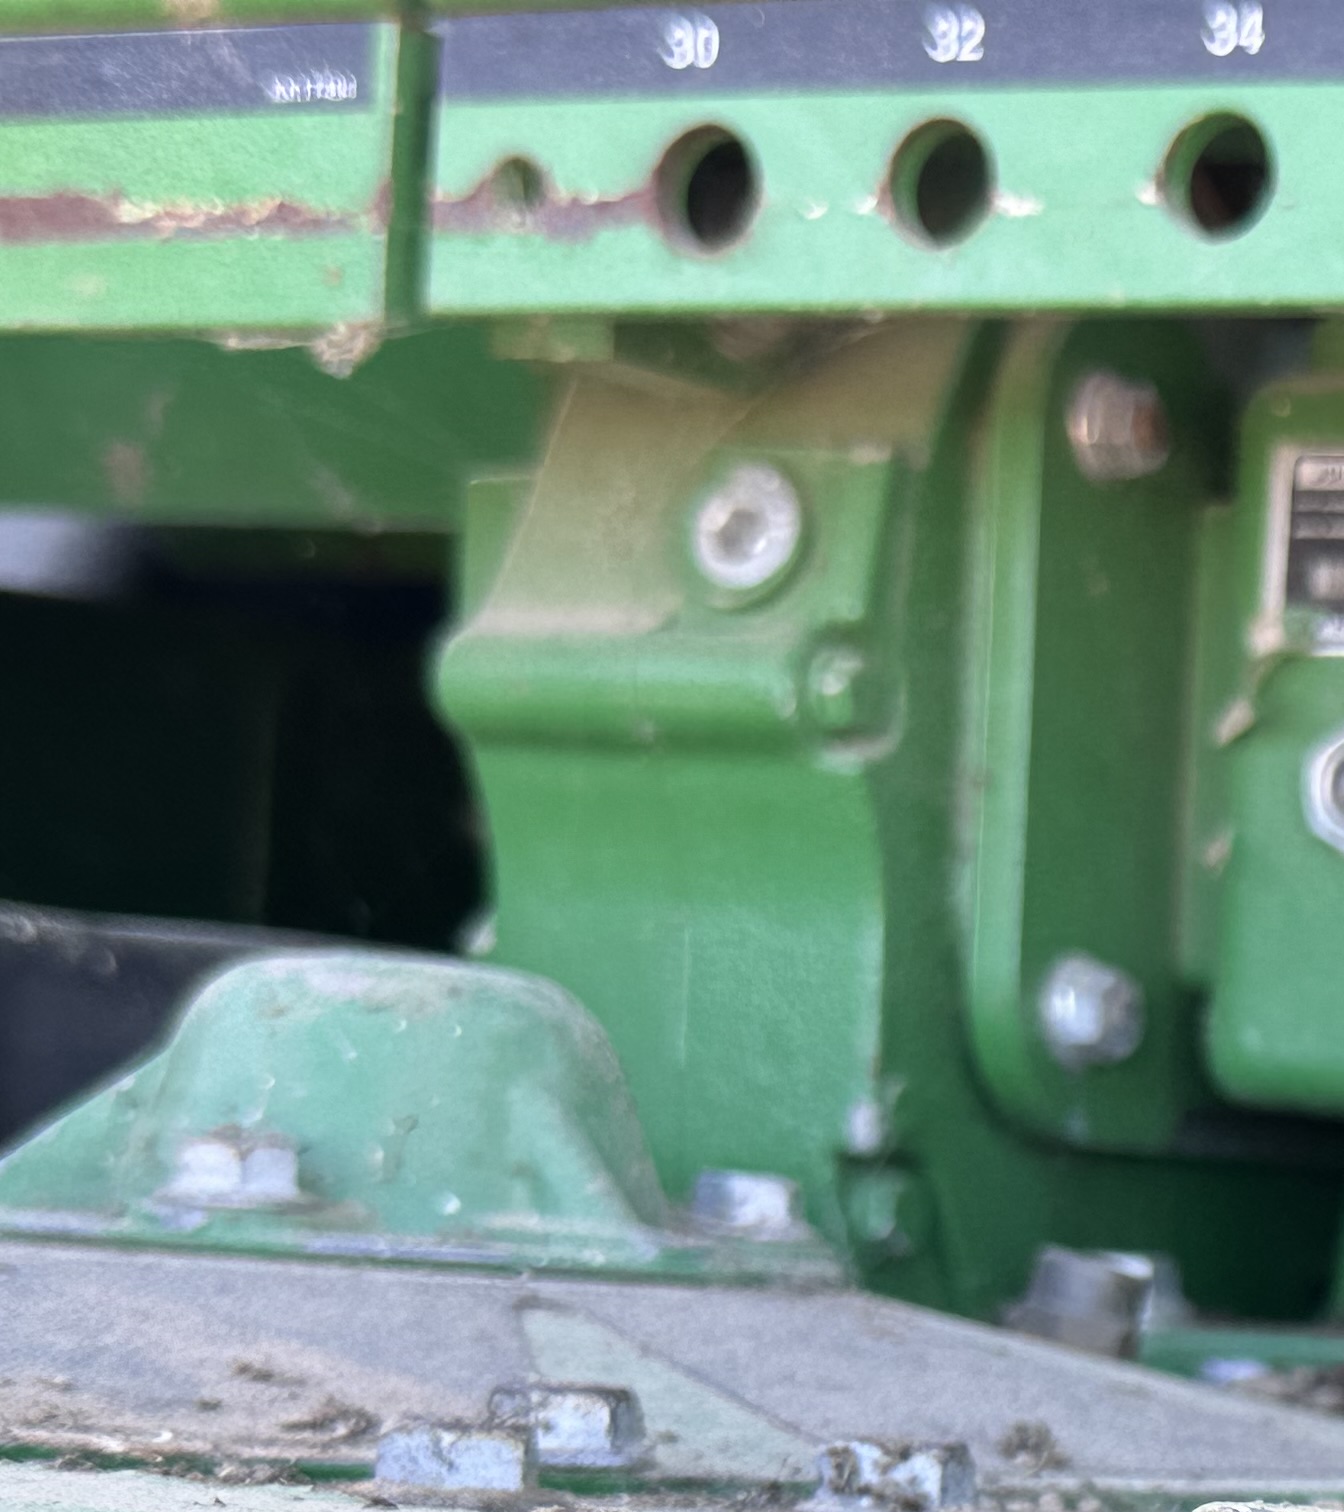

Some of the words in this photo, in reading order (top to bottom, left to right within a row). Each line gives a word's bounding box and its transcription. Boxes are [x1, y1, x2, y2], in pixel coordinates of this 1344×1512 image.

[659, 12, 720, 69] 30
[922, 3, 986, 63] 32
[1202, 0, 1265, 56] 34
